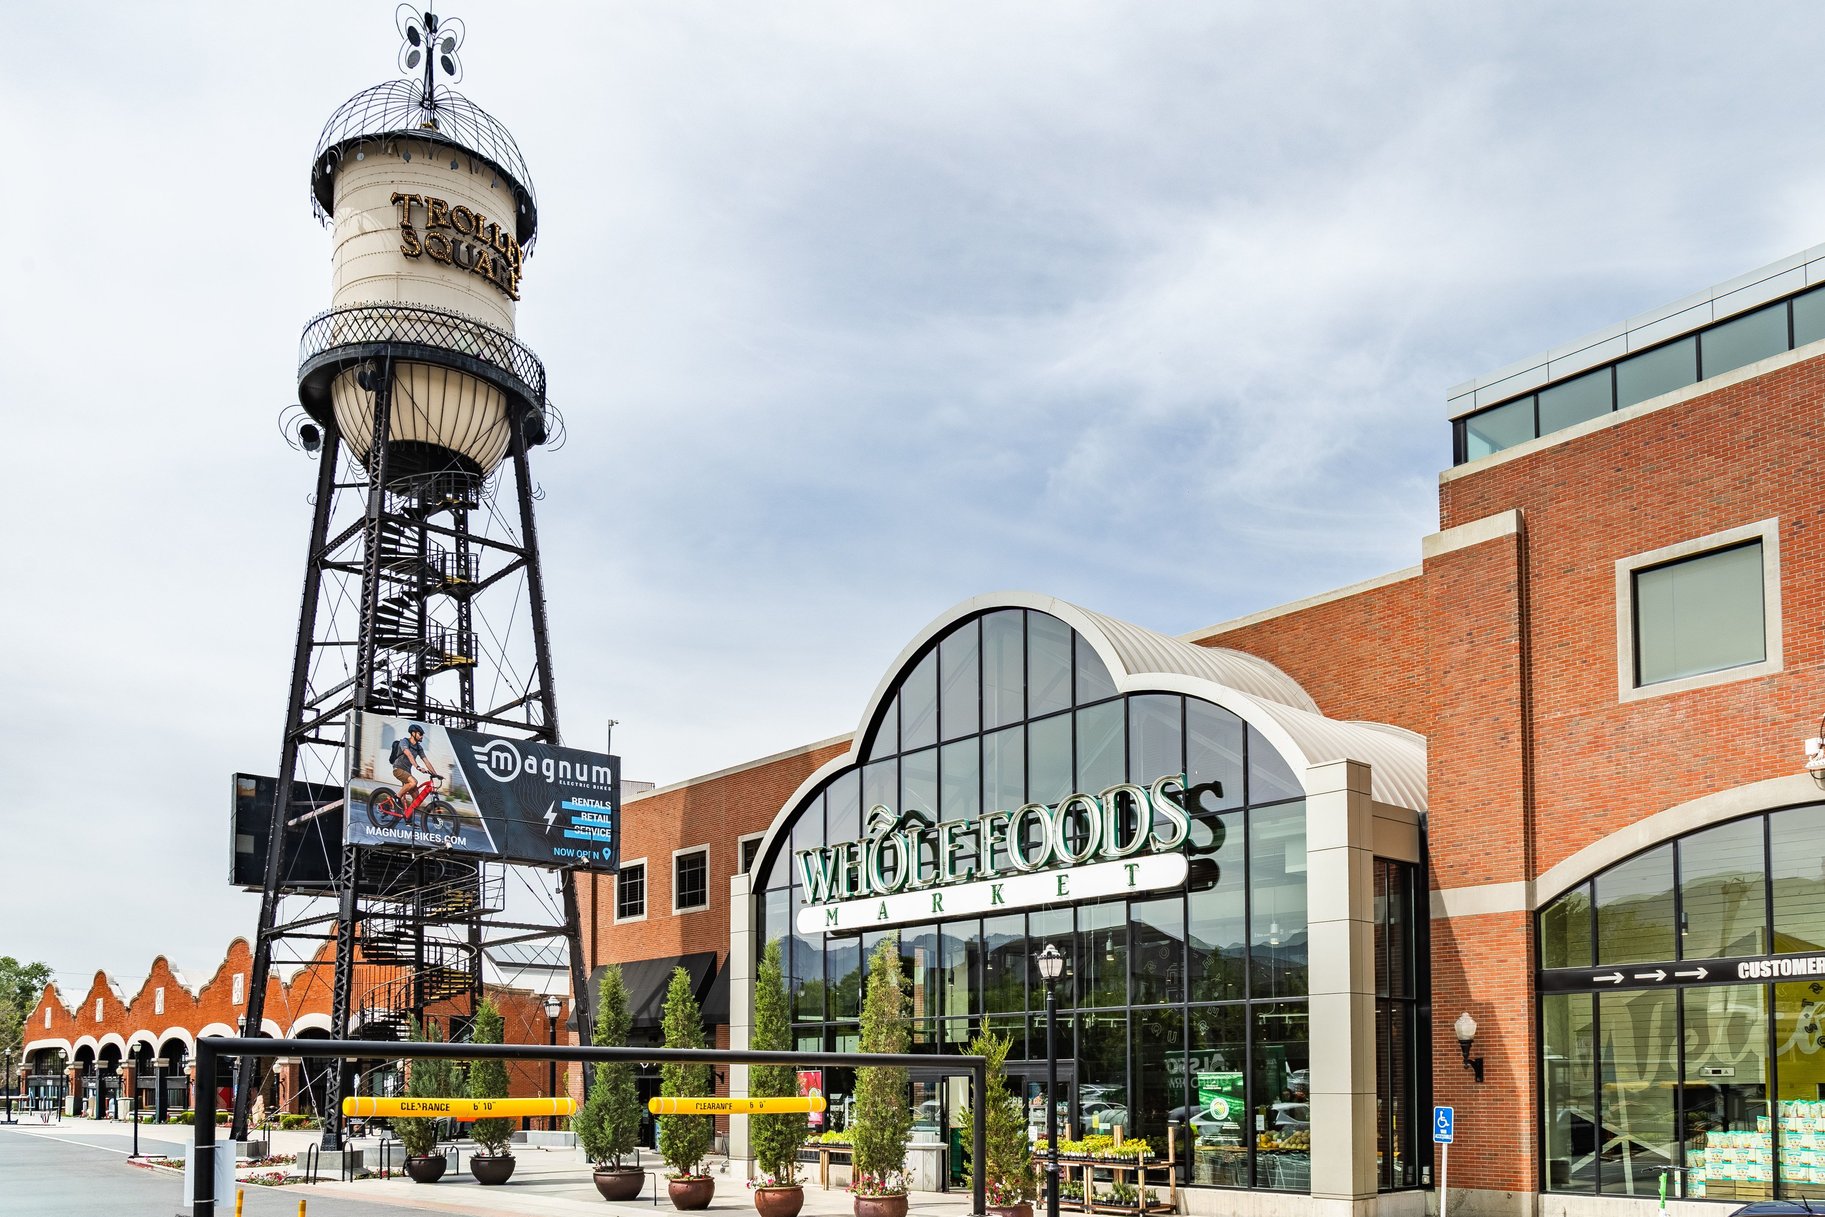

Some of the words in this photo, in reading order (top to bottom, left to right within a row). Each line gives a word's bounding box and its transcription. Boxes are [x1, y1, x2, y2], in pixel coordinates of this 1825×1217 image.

[559, 780, 590, 789] ELECTRIC
[592, 784, 612, 792] BIKES
[571, 797, 612, 810] RENTALS
[581, 812, 612, 823] RETAIL
[365, 825, 467, 845] MAGNUMBIKES.COM
[574, 825, 612, 838] SERVICE
[794, 804, 973, 904] WHOLE
[977, 772, 1192, 878] FOODS
[553, 847, 575, 857] NOW
[825, 862, 1140, 927] MARKET
